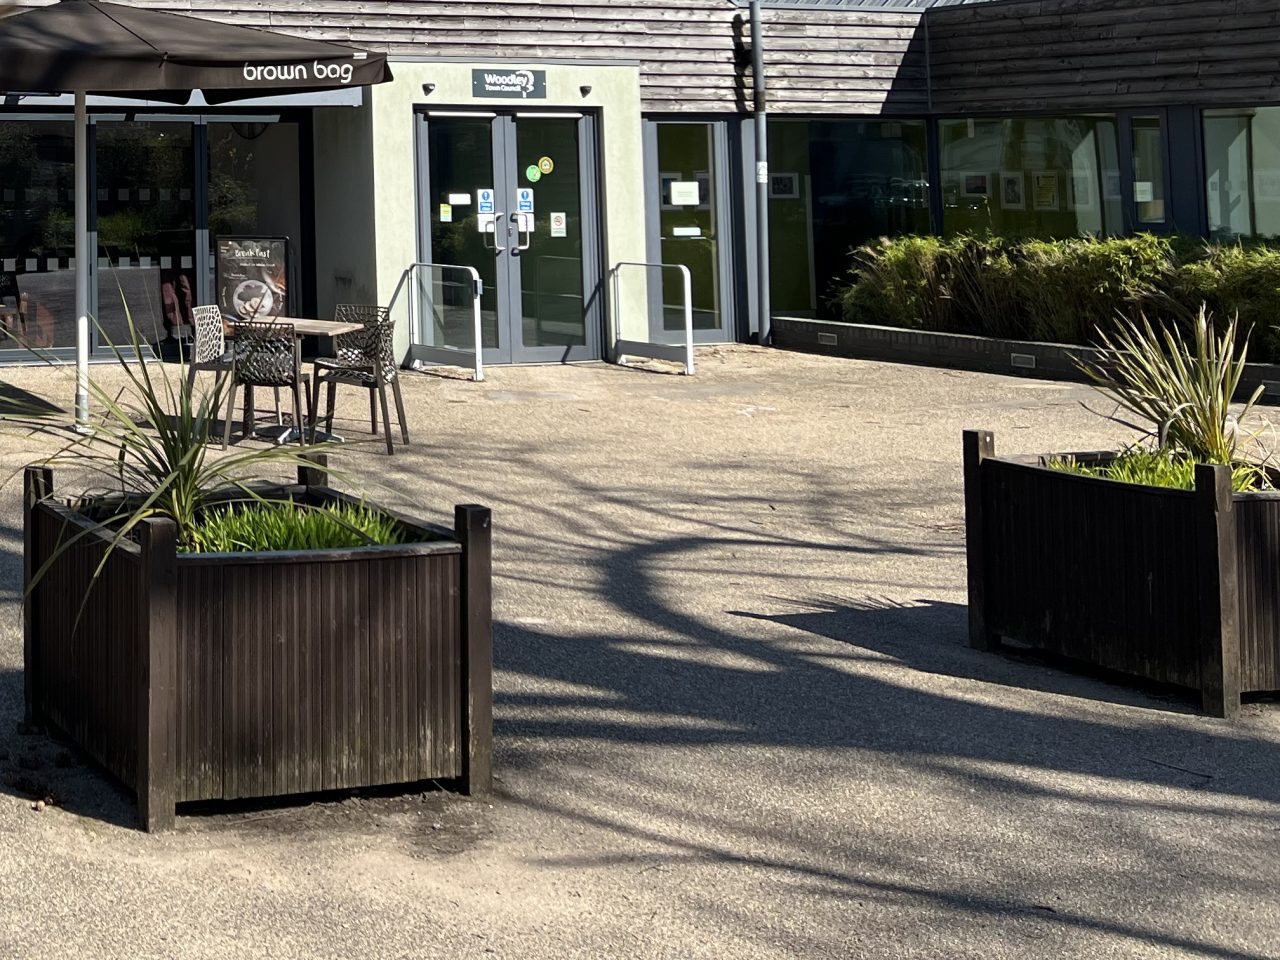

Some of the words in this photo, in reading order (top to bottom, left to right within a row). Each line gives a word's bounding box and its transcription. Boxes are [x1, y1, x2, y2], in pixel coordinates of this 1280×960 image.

[243, 62, 308, 80] brown
[313, 60, 354, 84] bag
[484, 73, 528, 87] Woodley
